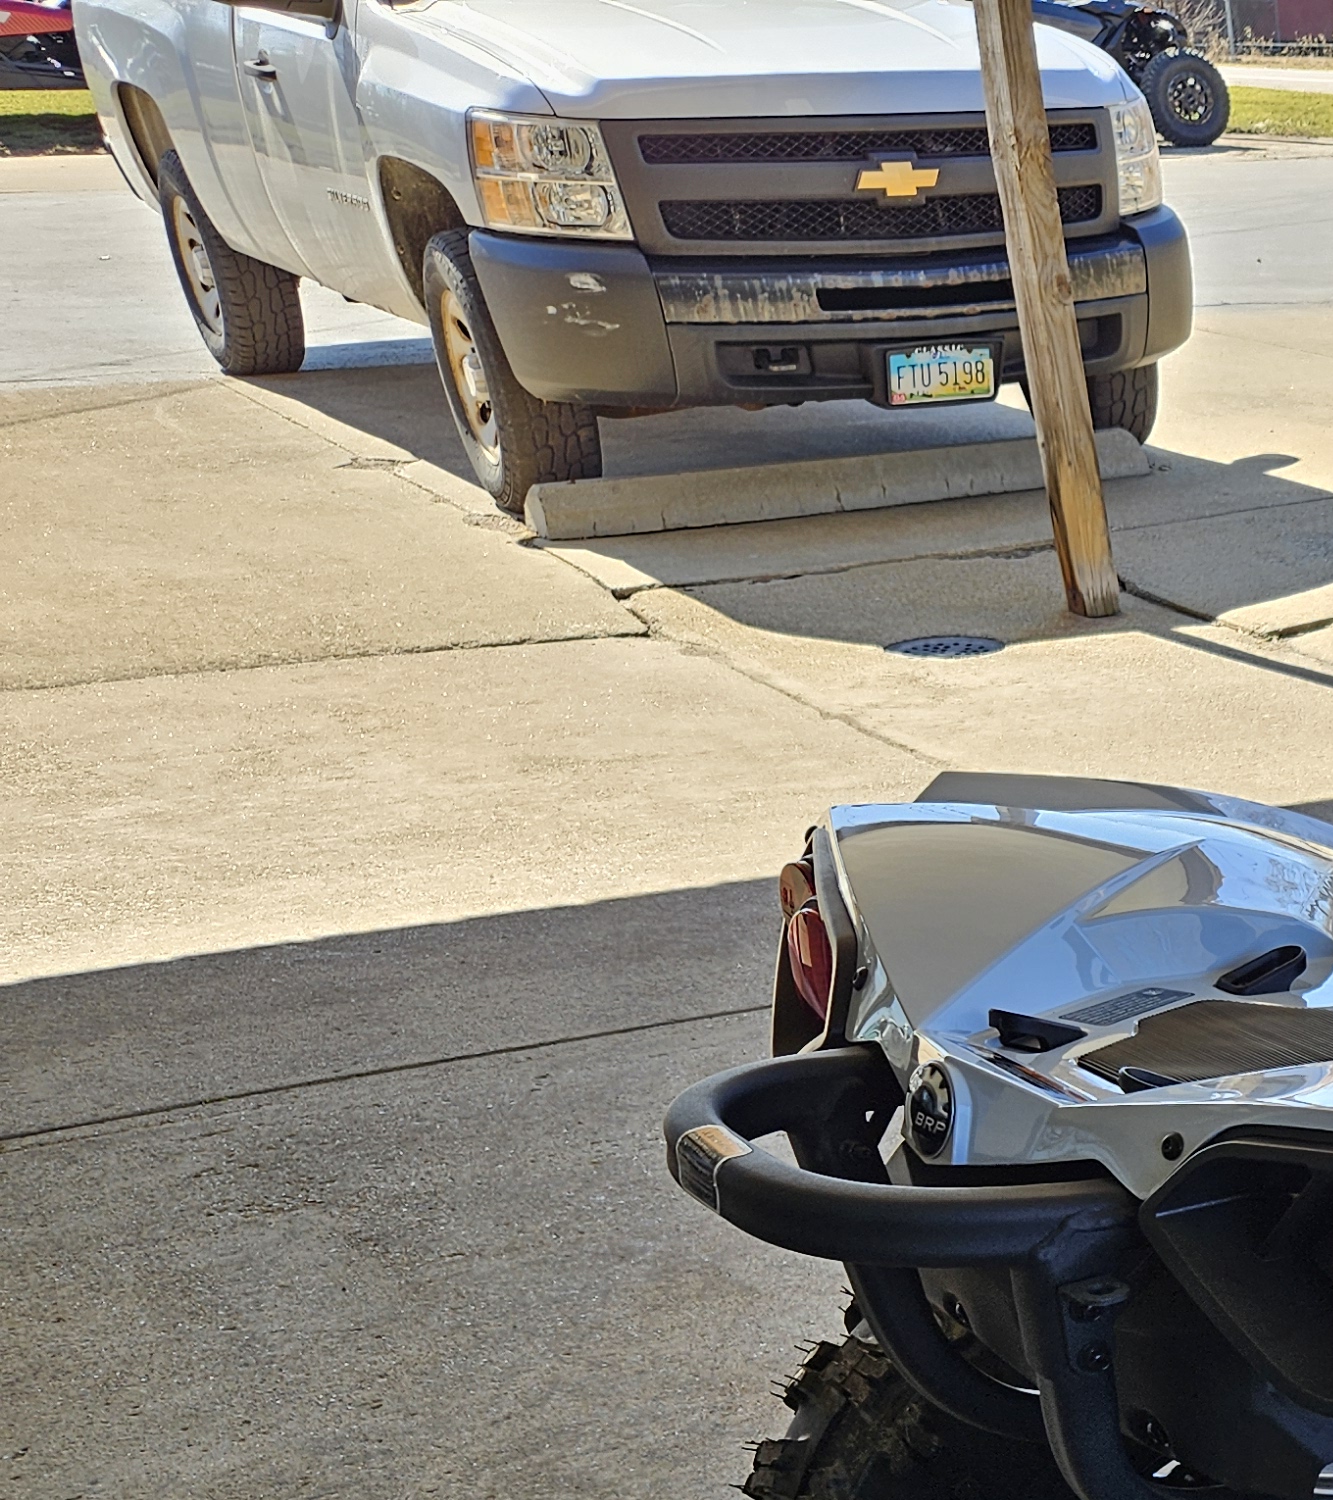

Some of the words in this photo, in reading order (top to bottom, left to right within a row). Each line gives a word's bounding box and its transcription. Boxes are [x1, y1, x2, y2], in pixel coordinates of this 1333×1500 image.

[896, 363, 932, 390] FTU
[938, 360, 985, 387] 5198
[914, 1111, 947, 1134] BRP
